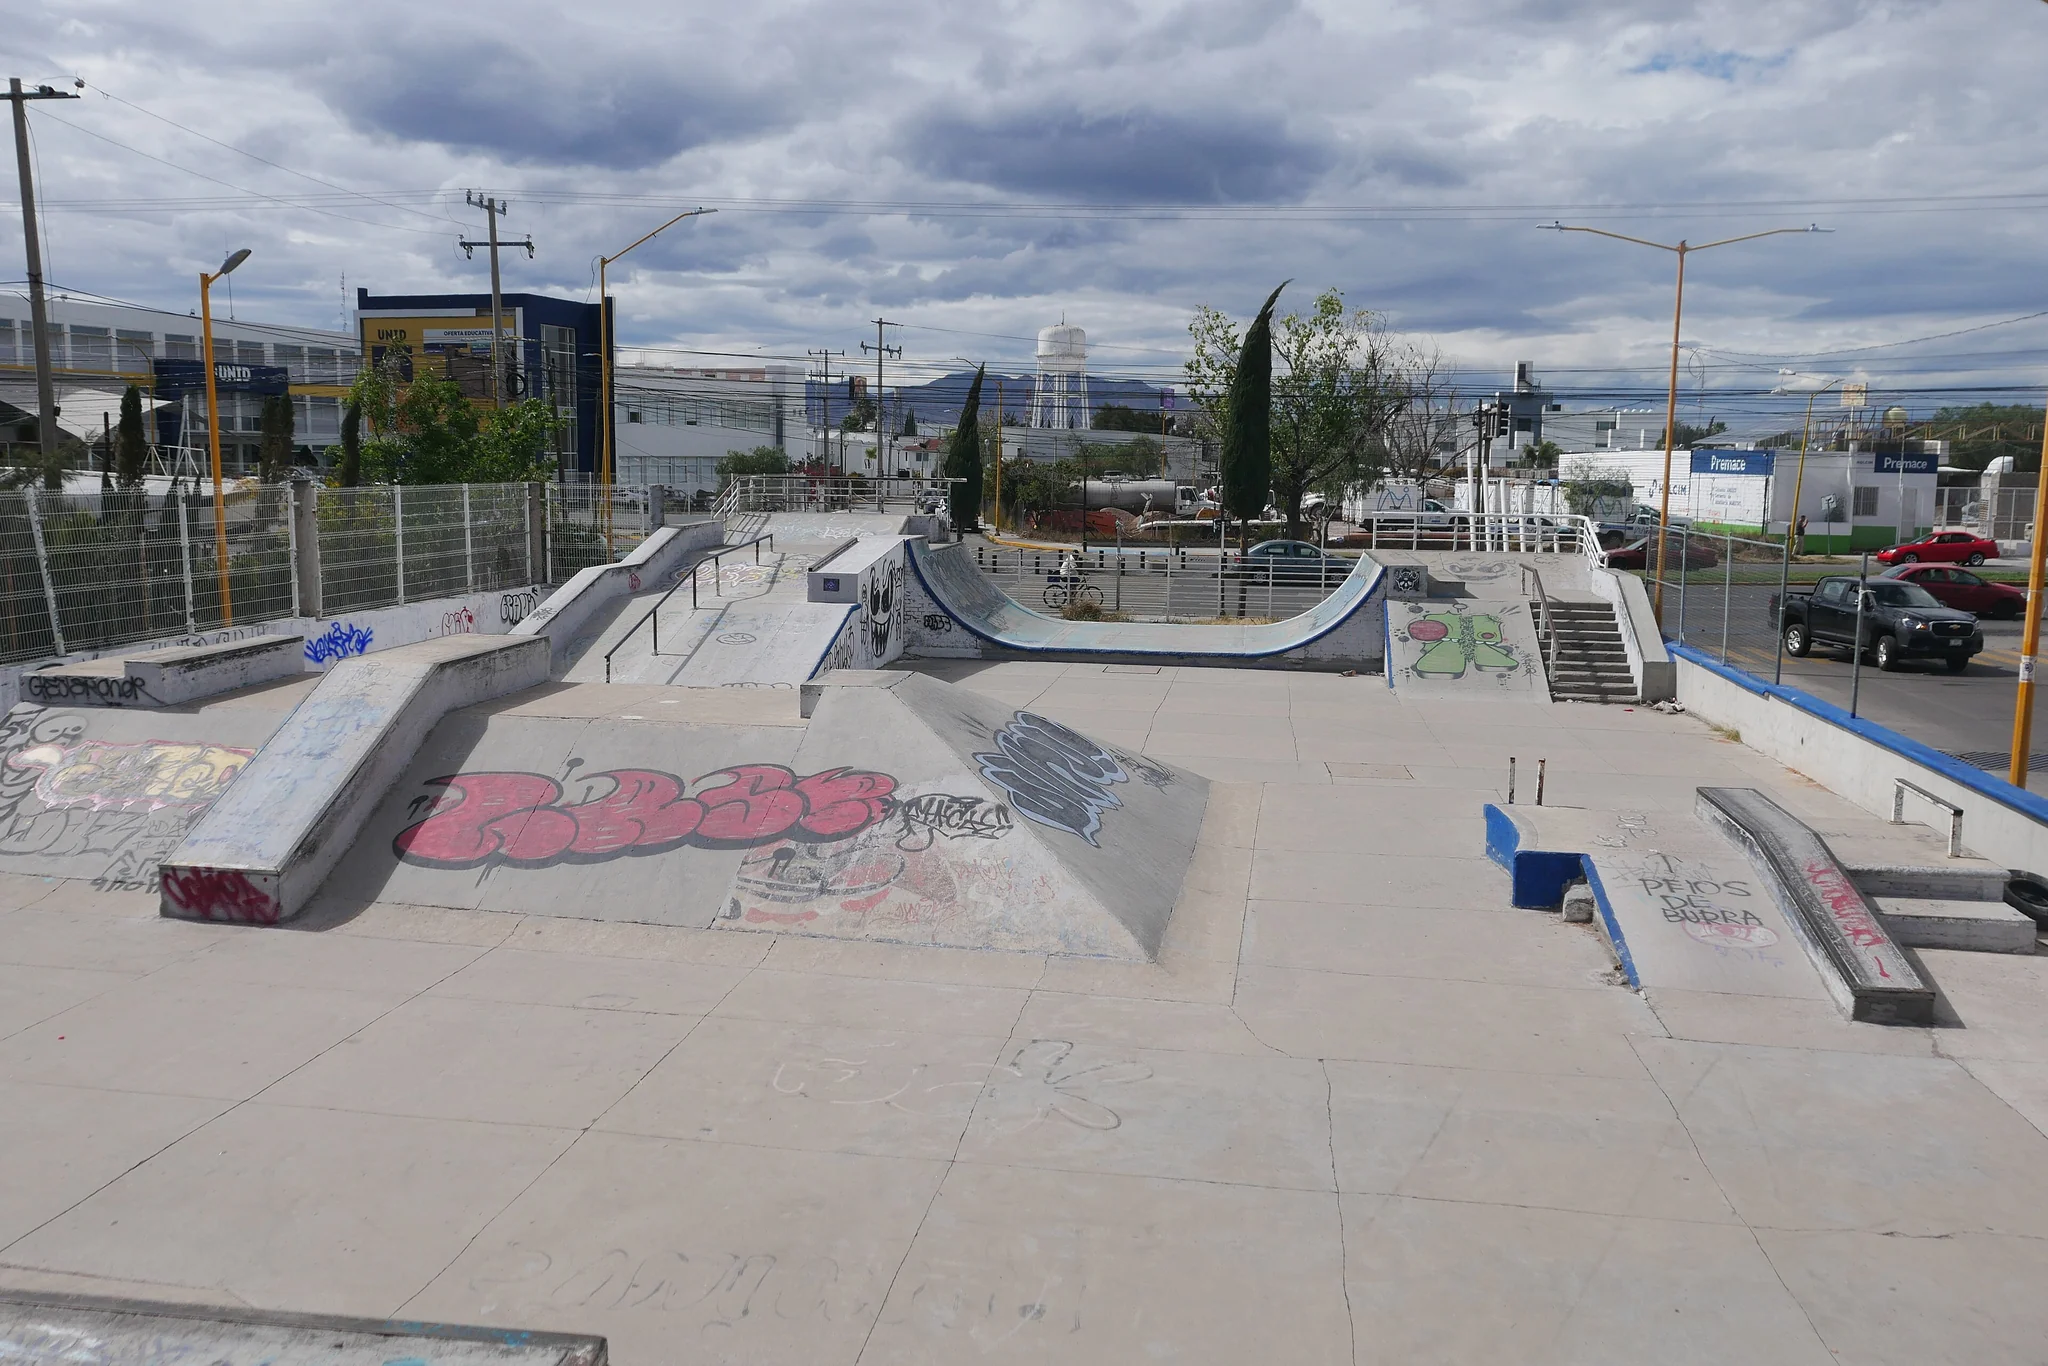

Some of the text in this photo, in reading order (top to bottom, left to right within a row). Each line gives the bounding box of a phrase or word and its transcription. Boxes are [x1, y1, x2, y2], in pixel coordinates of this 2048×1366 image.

[377, 329, 407, 340] UNID
[218, 365, 251, 381] UNID
[1710, 455, 1746, 471] Premace
[1883, 457, 1928, 469] Premace
[1658, 484, 1687, 496] HLCIM
[1660, 894, 1712, 910] DE
[1661, 908, 1764, 925] BURRA
